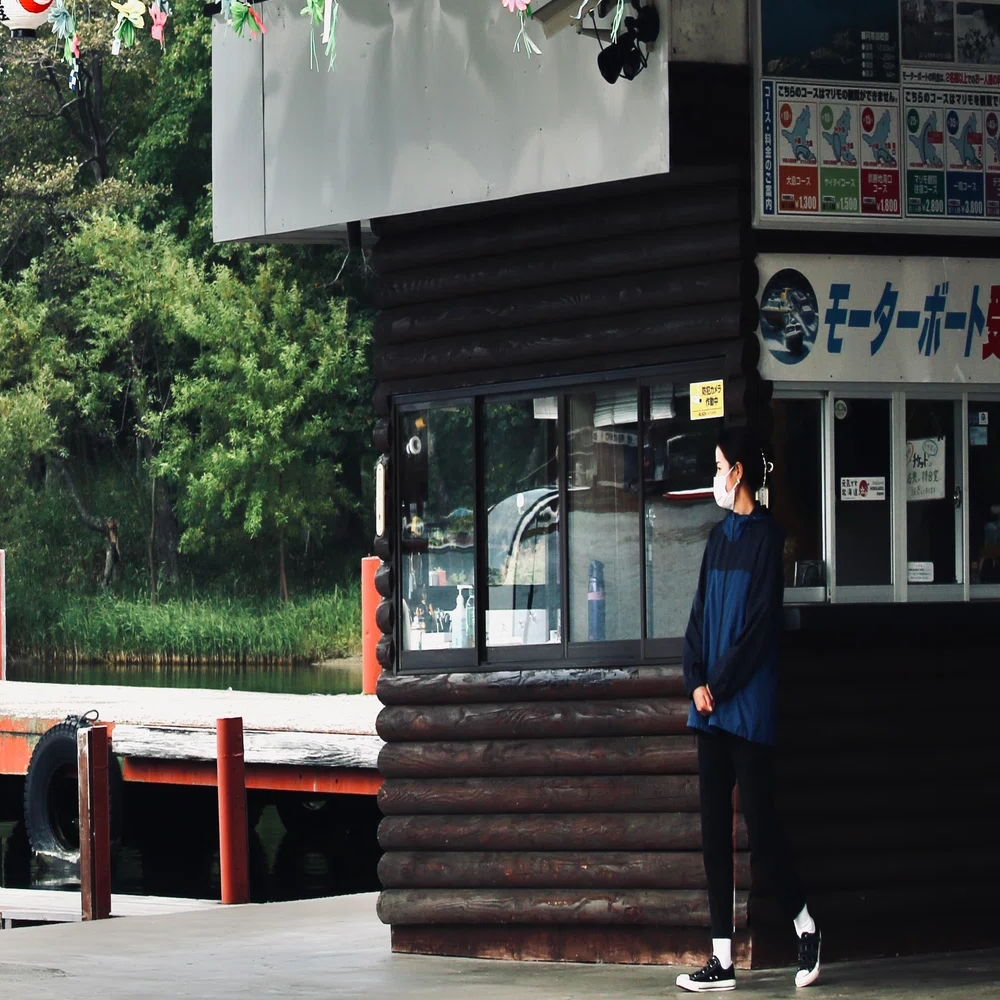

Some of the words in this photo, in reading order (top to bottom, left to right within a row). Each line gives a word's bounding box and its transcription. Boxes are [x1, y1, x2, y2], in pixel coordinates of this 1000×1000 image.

[824, 281, 986, 358] モーターボート
